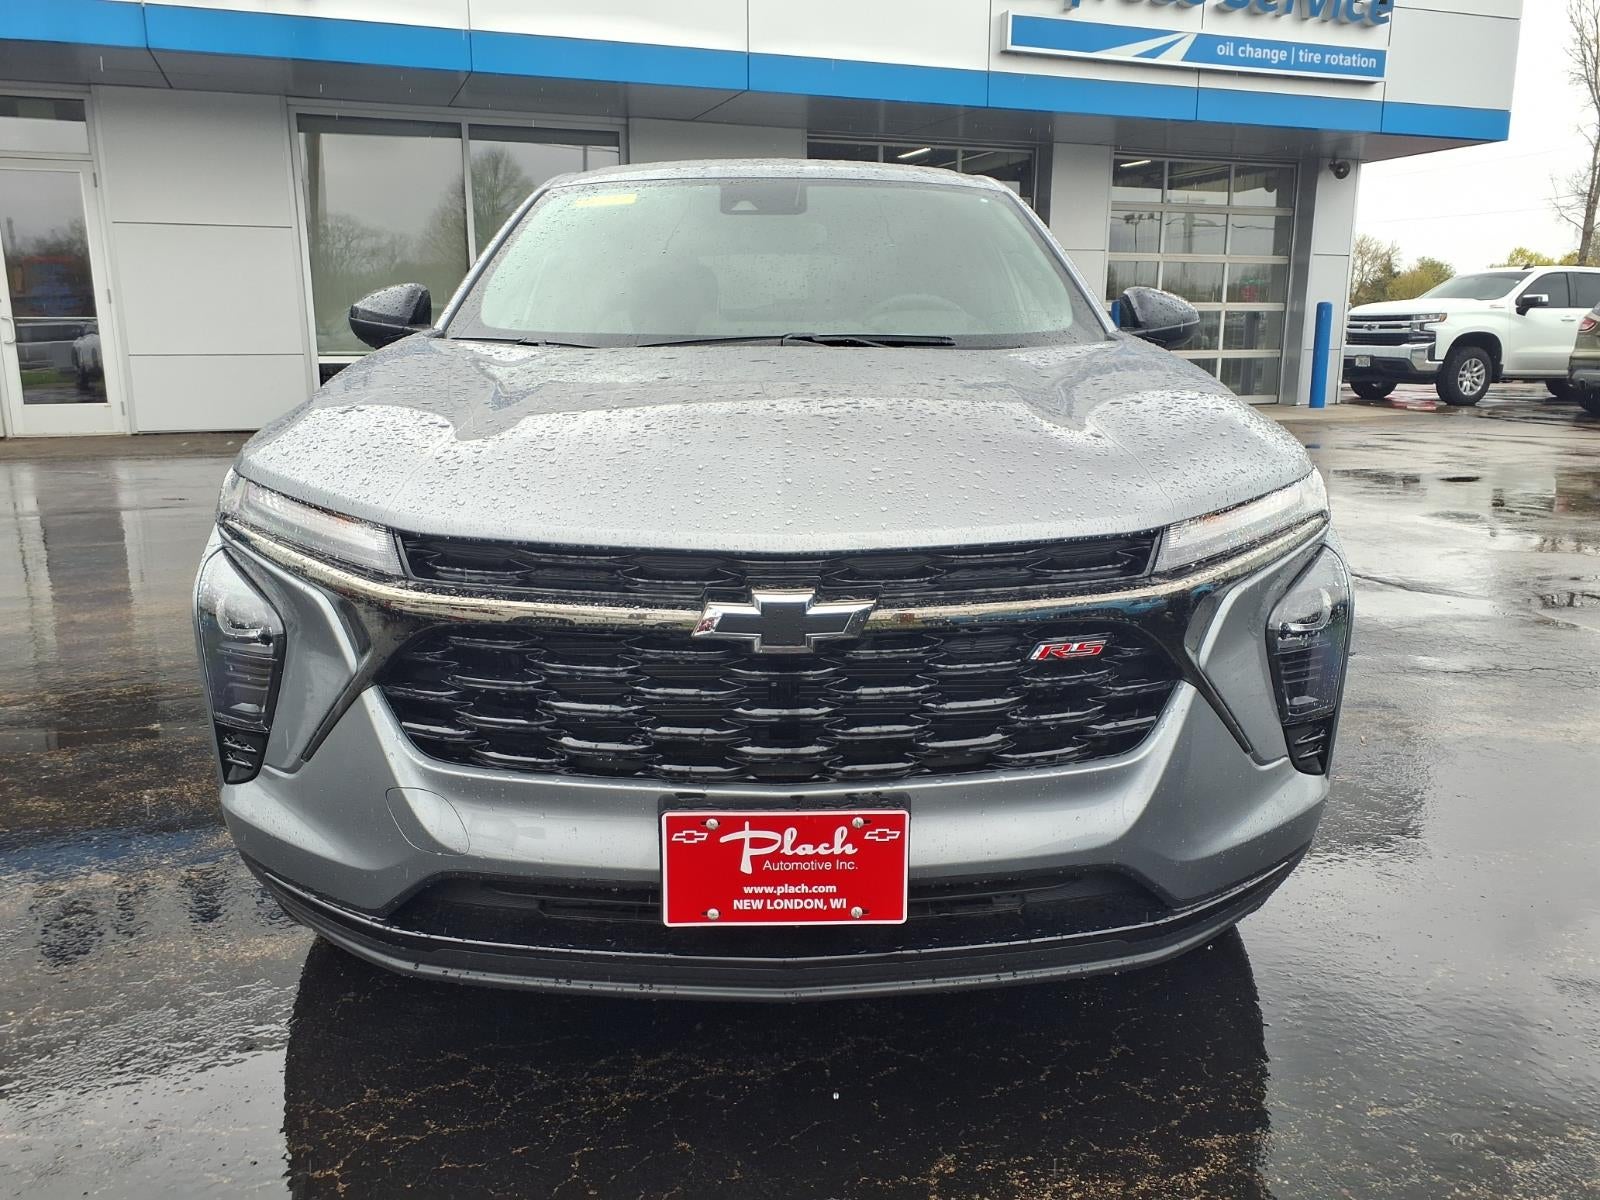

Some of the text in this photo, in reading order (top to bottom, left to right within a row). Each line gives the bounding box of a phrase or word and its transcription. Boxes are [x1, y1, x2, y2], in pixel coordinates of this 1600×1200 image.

[1219, 0, 1394, 25] rvice
[1216, 42, 1377, 68] oil change tire rotation
[1031, 640, 1107, 660] RS
[719, 821, 858, 875] Plach
[762, 859, 859, 871] Automotive Inc.
[743, 883, 837, 895] www.plach.com
[733, 898, 847, 911] NEW LONDON, WI
